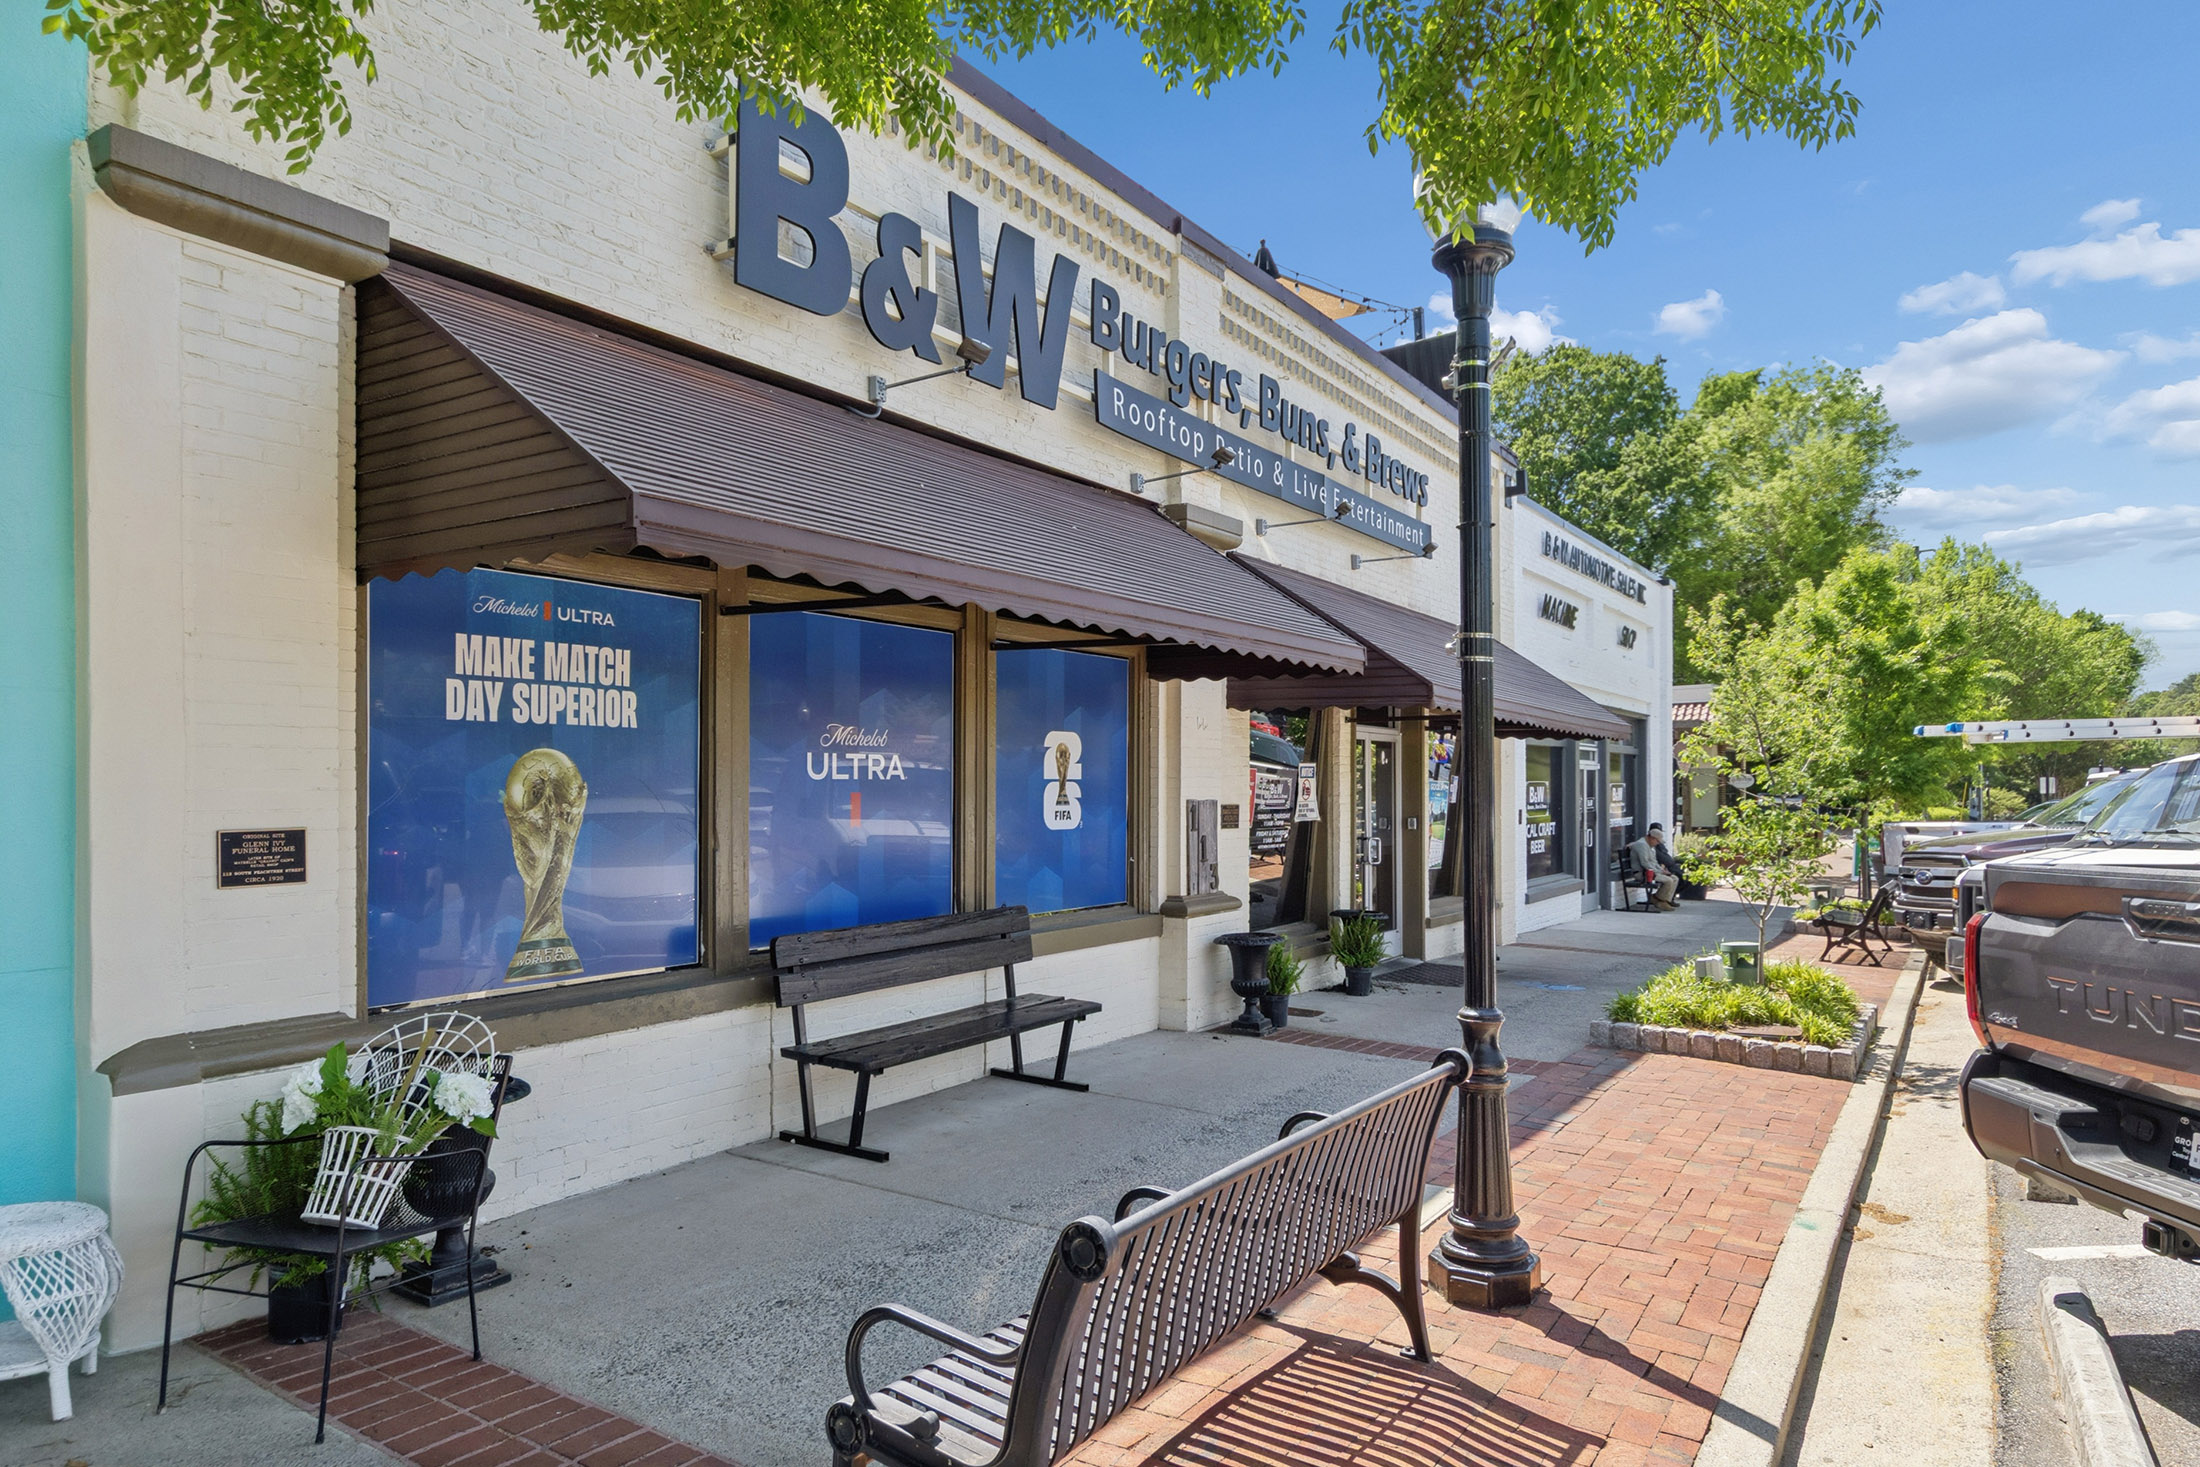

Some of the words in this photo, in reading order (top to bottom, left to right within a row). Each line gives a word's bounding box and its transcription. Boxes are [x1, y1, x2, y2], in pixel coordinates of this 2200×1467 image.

[1091, 278, 1251, 429] Burgers,
[1259, 373, 1335, 469] Buns,
[1342, 423, 1361, 474] &
[1366, 433, 1429, 506] Brews
[1114, 388, 1204, 458] Rooftop
[1273, 461, 1284, 487] &
[1294, 478, 1327, 504] Live
[473, 596, 538, 617] Michelob
[558, 607, 615, 627] ULTRA
[455, 633, 535, 680] MAKE
[545, 641, 630, 687] MATCH
[446, 678, 504, 722] DAY
[512, 683, 637, 728] SUPERIOR
[820, 723, 889, 746] Michelob
[807, 752, 905, 780] ULTRA
[1055, 811, 1072, 820] FIFA
[1538, 822, 1556, 836] CRAFT
[1530, 839, 1546, 854] BEER
[517, 956, 552, 967] WORLD
[555, 953, 574, 962] CUP
[525, 947, 565, 958] FIFA
